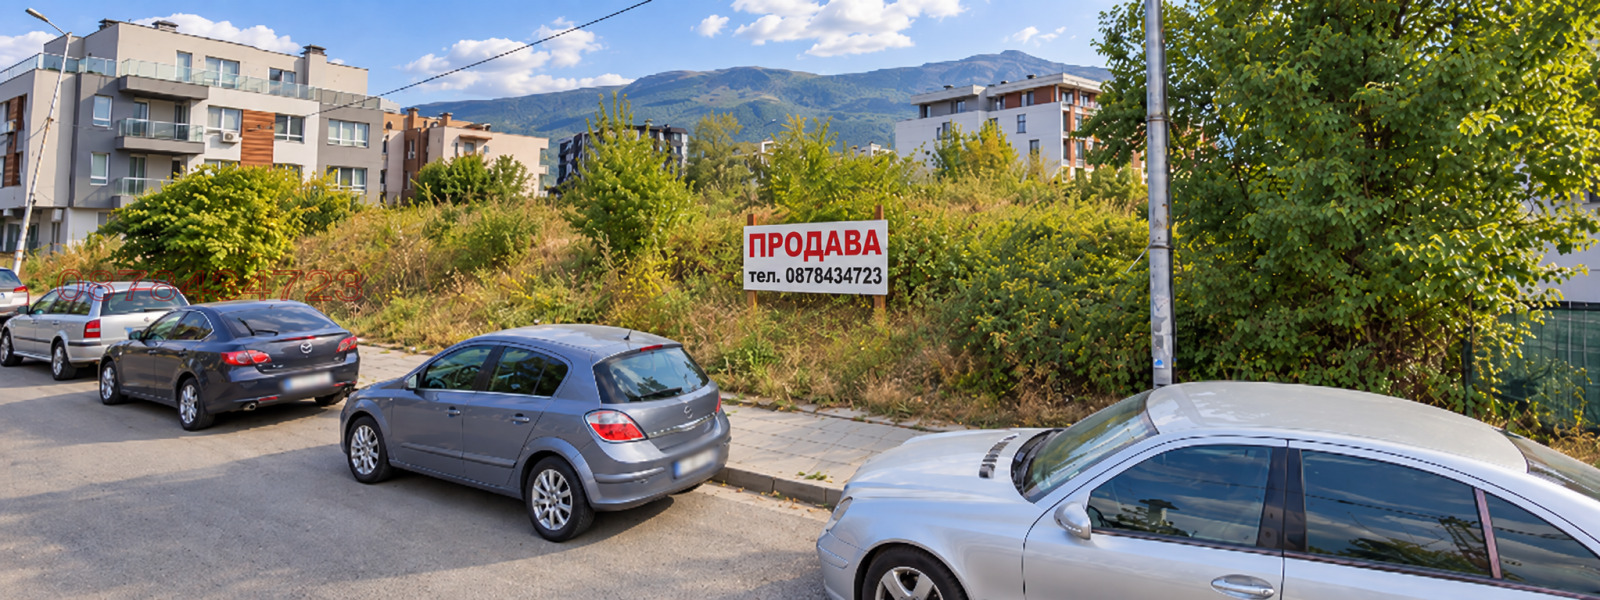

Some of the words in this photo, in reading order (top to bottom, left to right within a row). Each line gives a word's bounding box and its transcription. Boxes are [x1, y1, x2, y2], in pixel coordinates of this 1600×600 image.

[749, 229, 882, 262] ПРОДАВА
[748, 270, 781, 283] тел.
[785, 267, 882, 284] 0878434723
